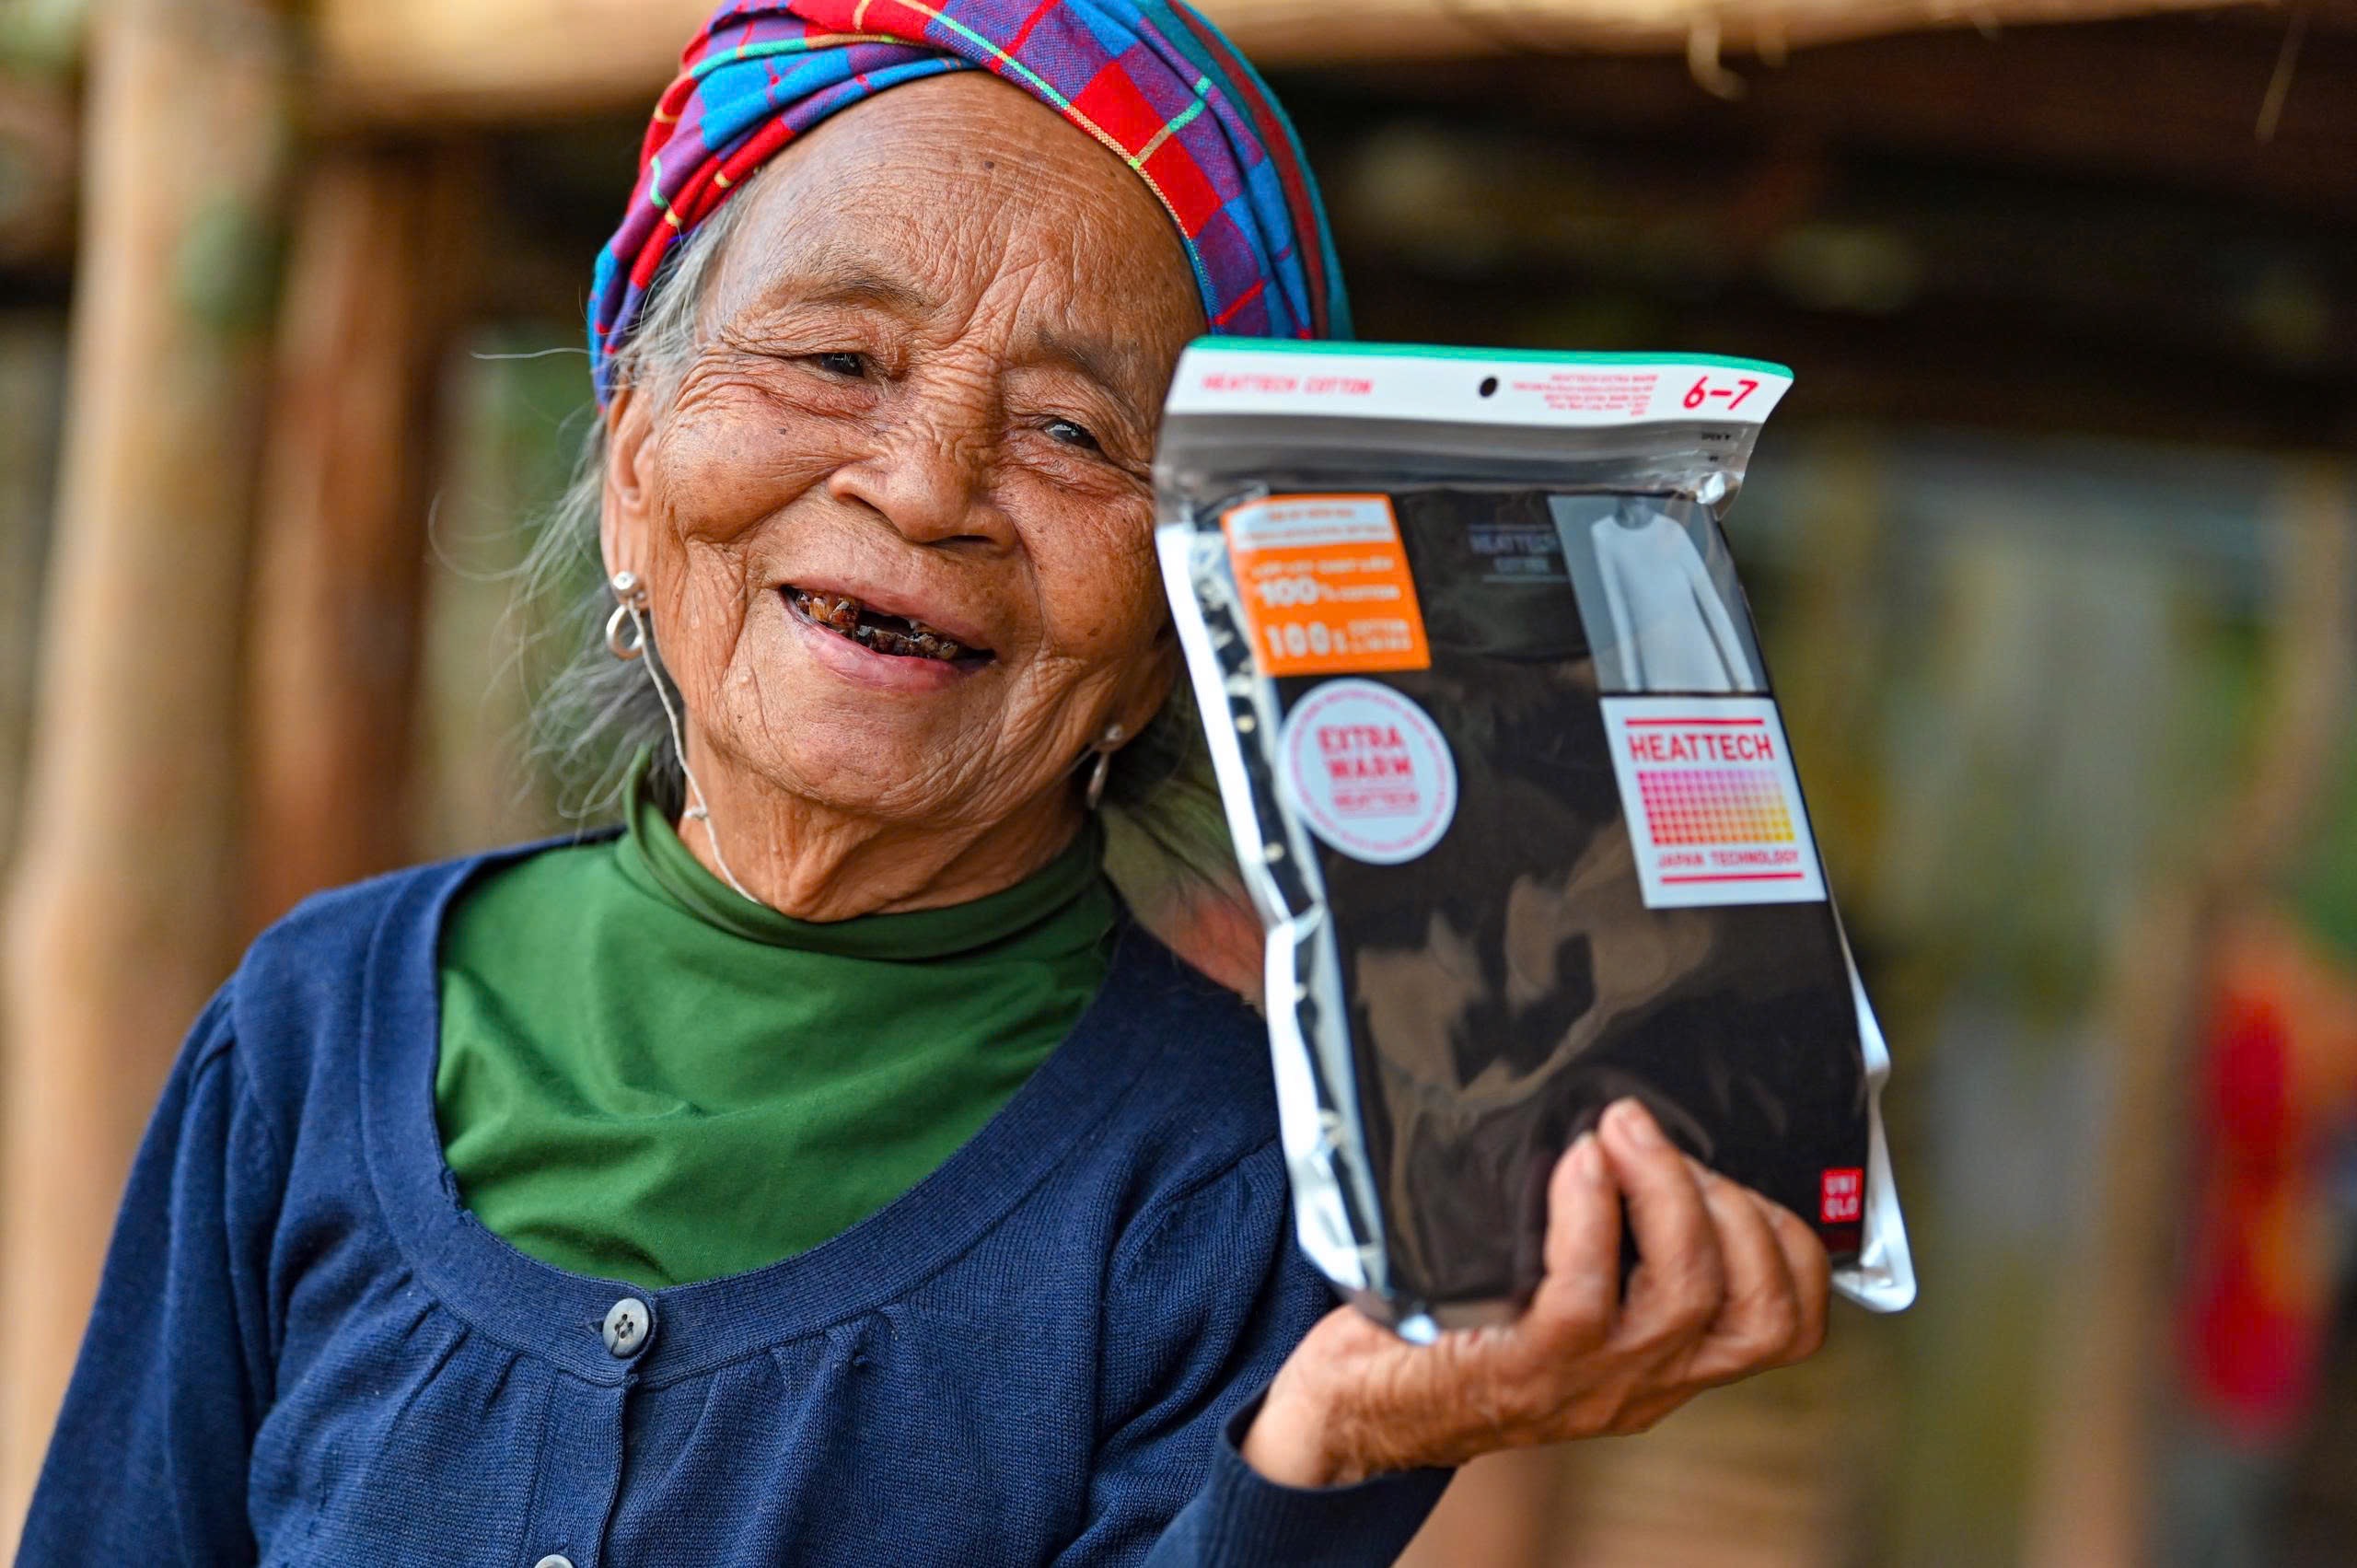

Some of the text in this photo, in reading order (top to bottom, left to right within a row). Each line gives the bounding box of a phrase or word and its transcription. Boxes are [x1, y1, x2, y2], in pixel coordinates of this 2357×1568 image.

[1318, 724, 1405, 753] EXTRA
[1627, 733, 1776, 762] HEATTECH
[1327, 755, 1414, 779] WARM
[1657, 848, 1799, 870] JAPAN TECHNOLOGY
[1824, 1174, 1858, 1195] UNI
[1824, 1196, 1858, 1220] QLO
